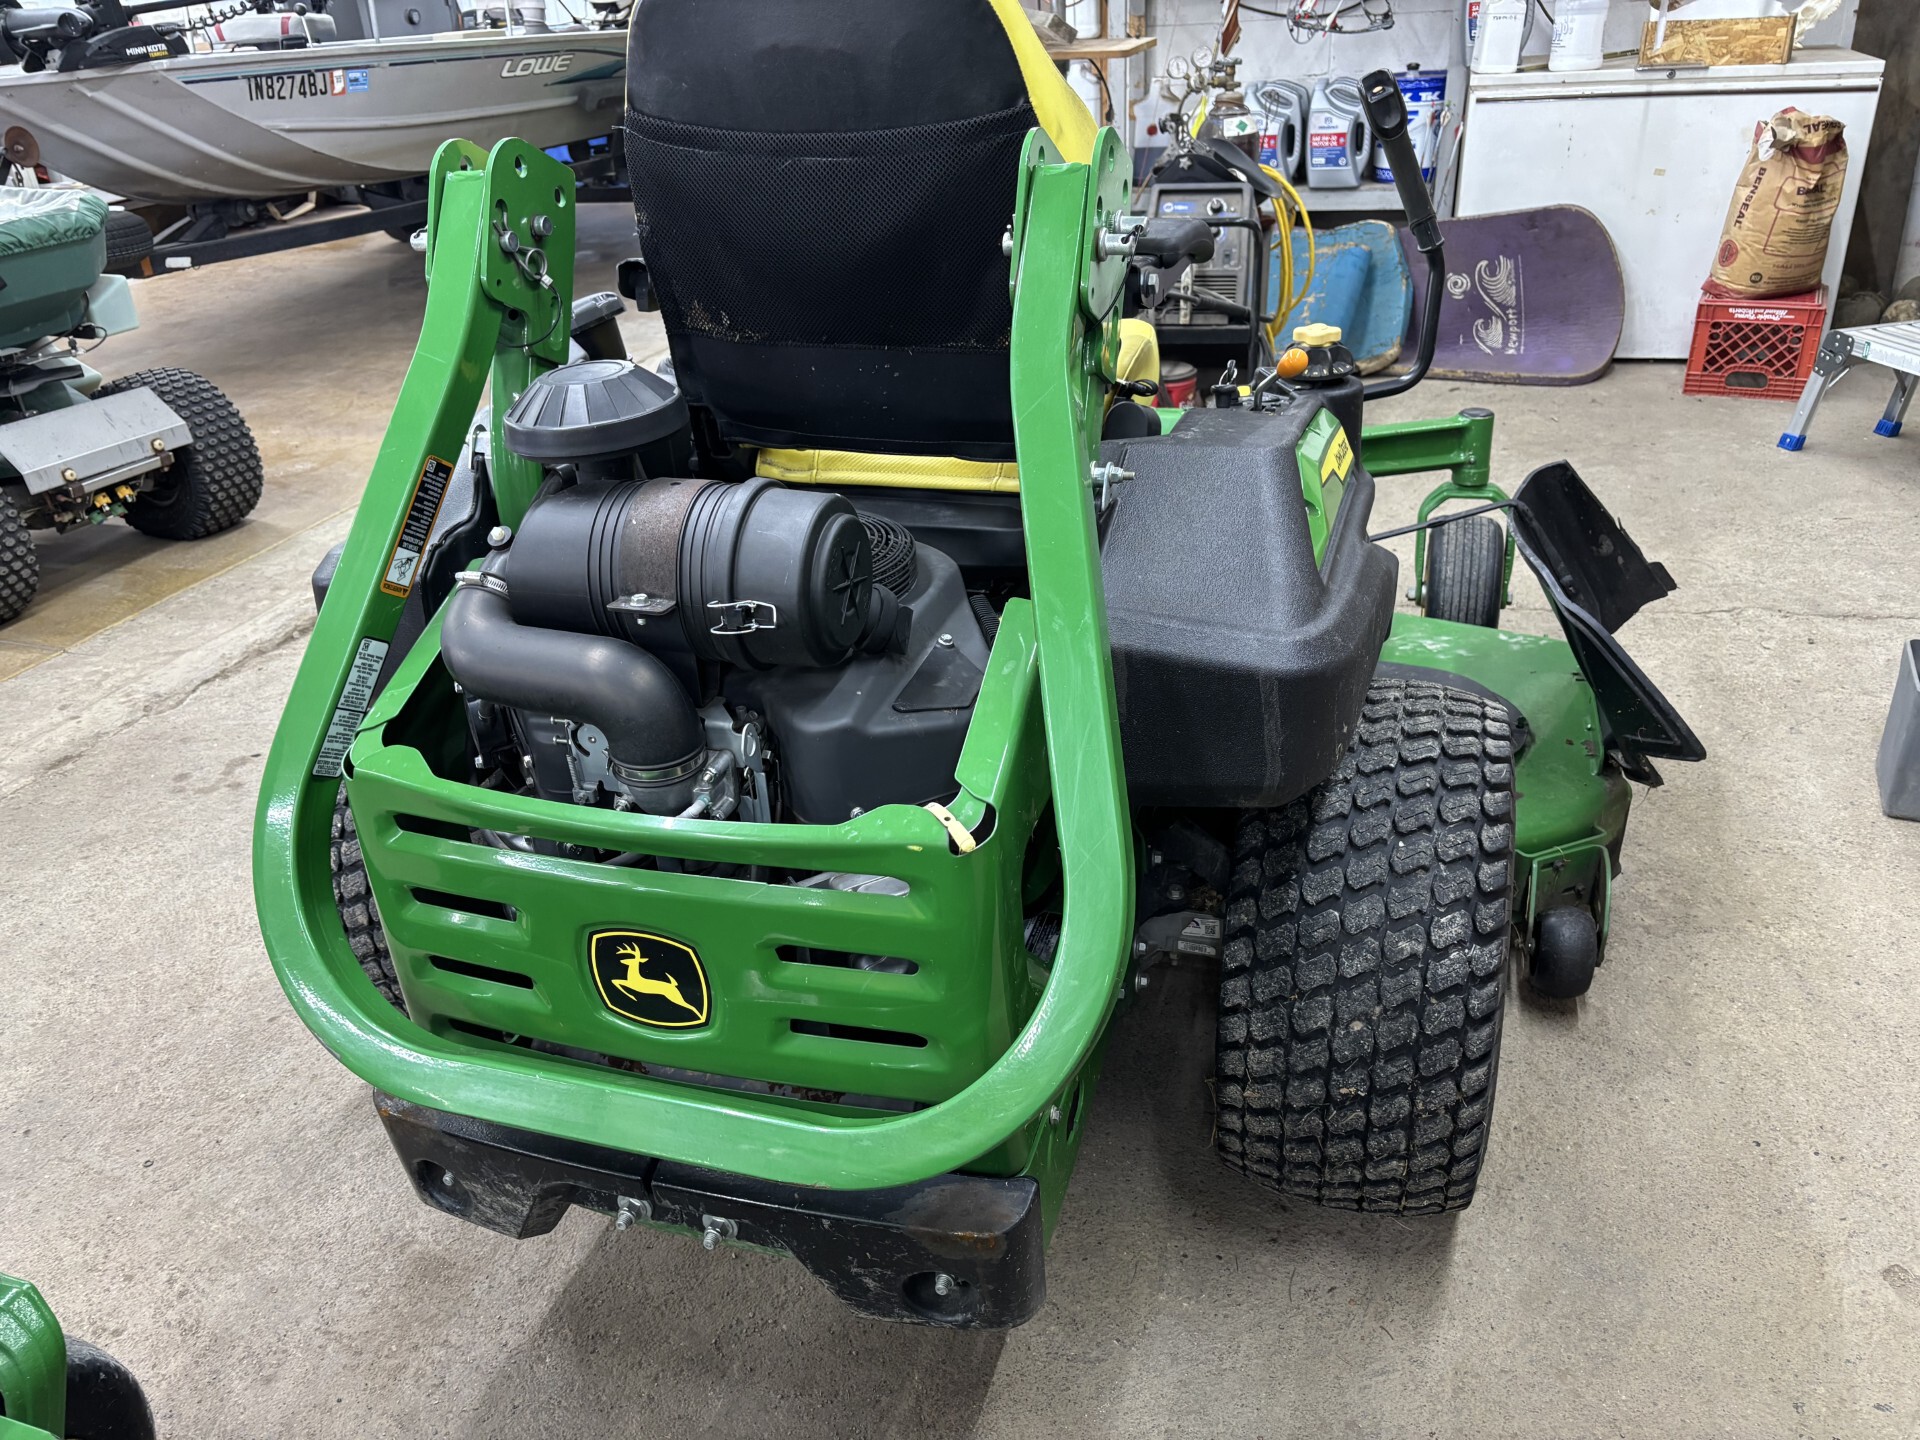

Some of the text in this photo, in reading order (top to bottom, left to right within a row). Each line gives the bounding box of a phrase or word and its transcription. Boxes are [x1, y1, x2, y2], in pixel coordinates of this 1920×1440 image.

[125, 43, 168, 56] MINN KOTA
[500, 53, 575, 79] LOWE
[1733, 166, 1767, 228] BENSEAL
[1504, 308, 1521, 355] Newport
